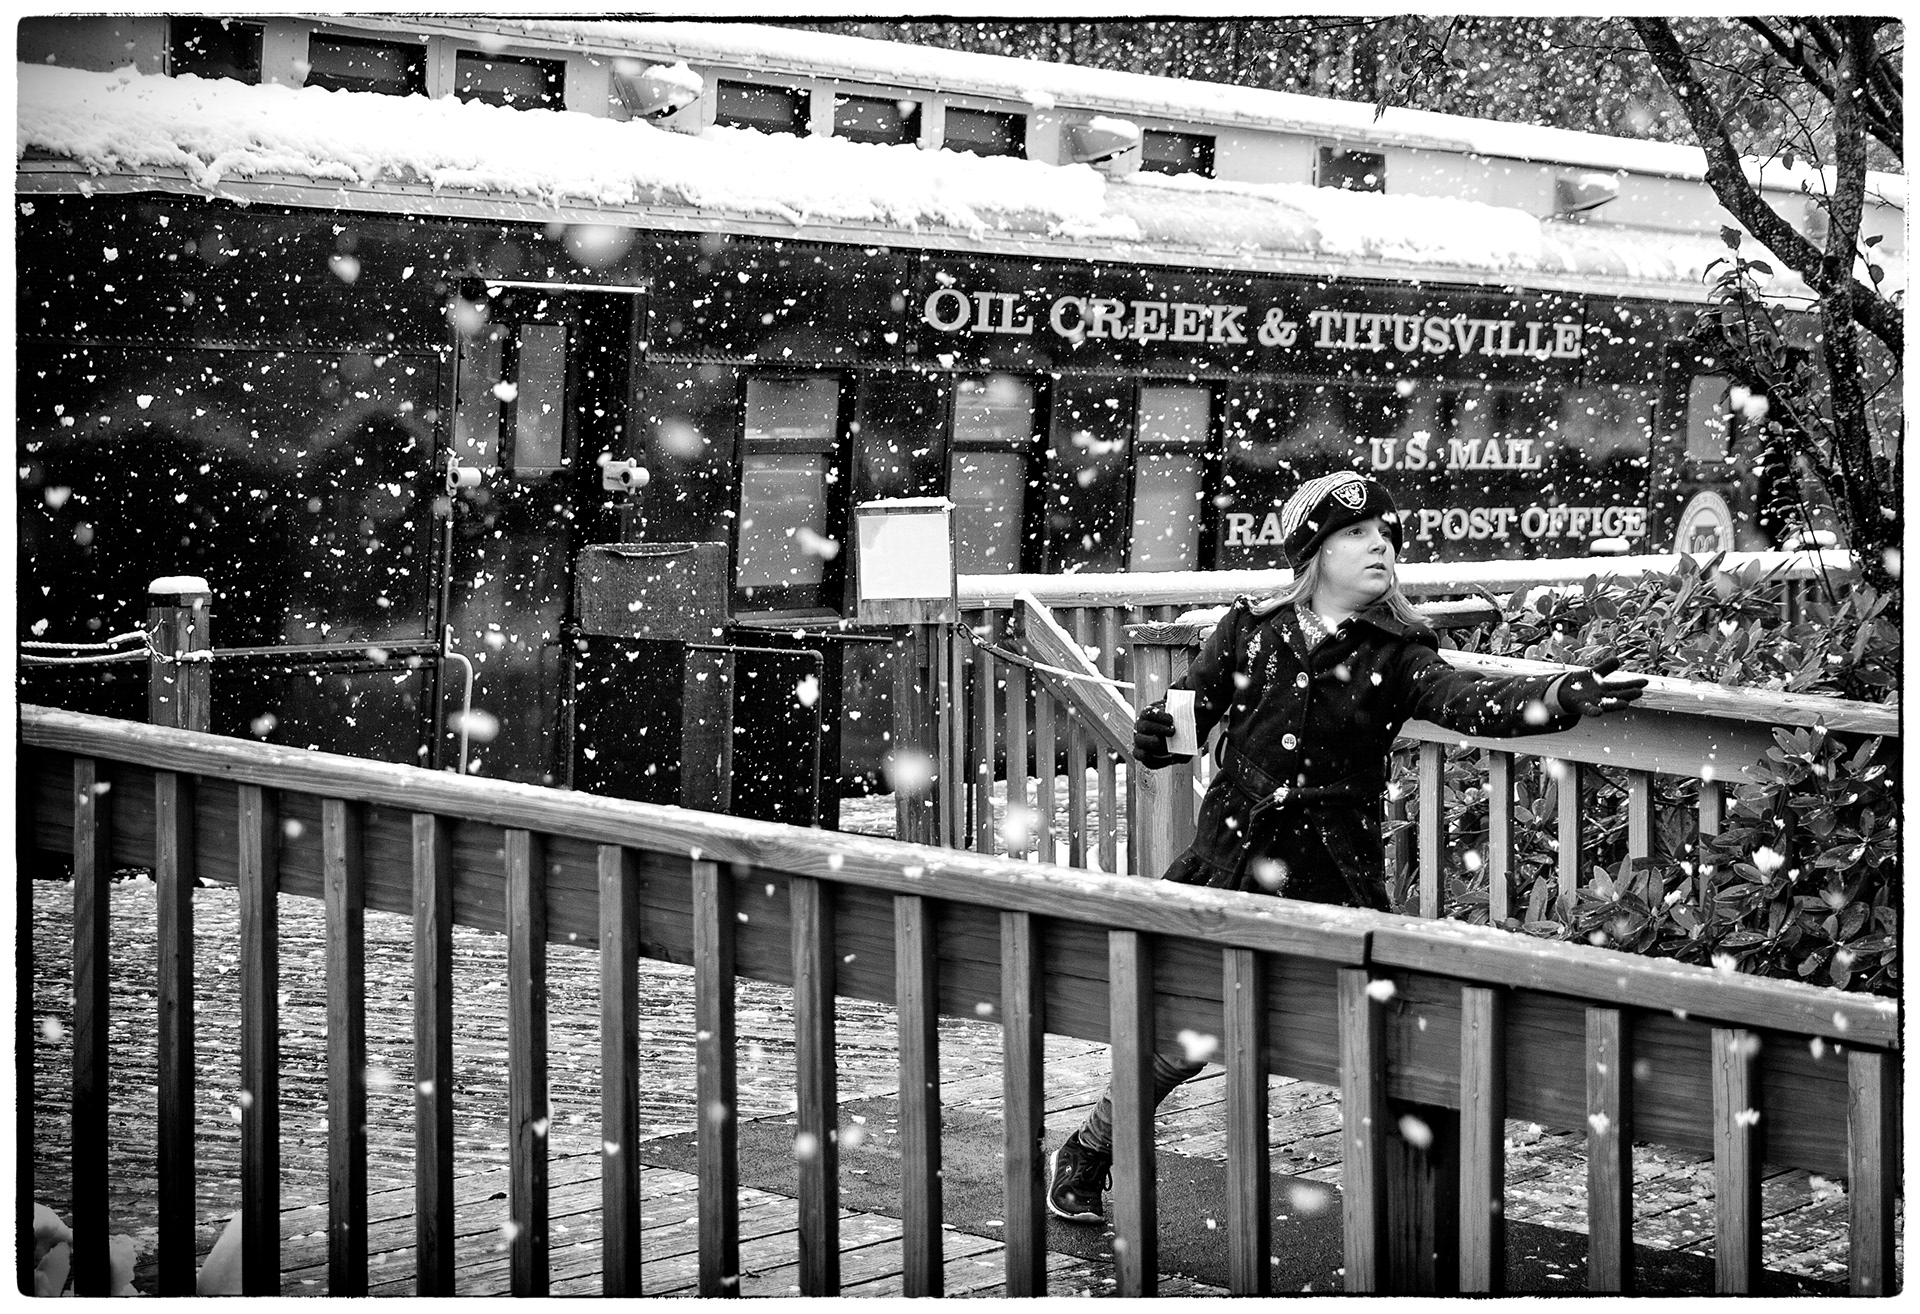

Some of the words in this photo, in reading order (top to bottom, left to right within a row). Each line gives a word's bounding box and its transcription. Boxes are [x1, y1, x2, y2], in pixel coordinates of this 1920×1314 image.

[924, 288, 1034, 335] OIL
[1049, 295, 1248, 344] CREEK
[1257, 307, 1298, 347] &
[1310, 310, 1583, 359] TITUSVILLE
[1369, 437, 1437, 471] U.S.
[1446, 438, 1542, 470] MAIL
[1416, 507, 1516, 541] POST
[1521, 506, 1648, 539] OFFICE
